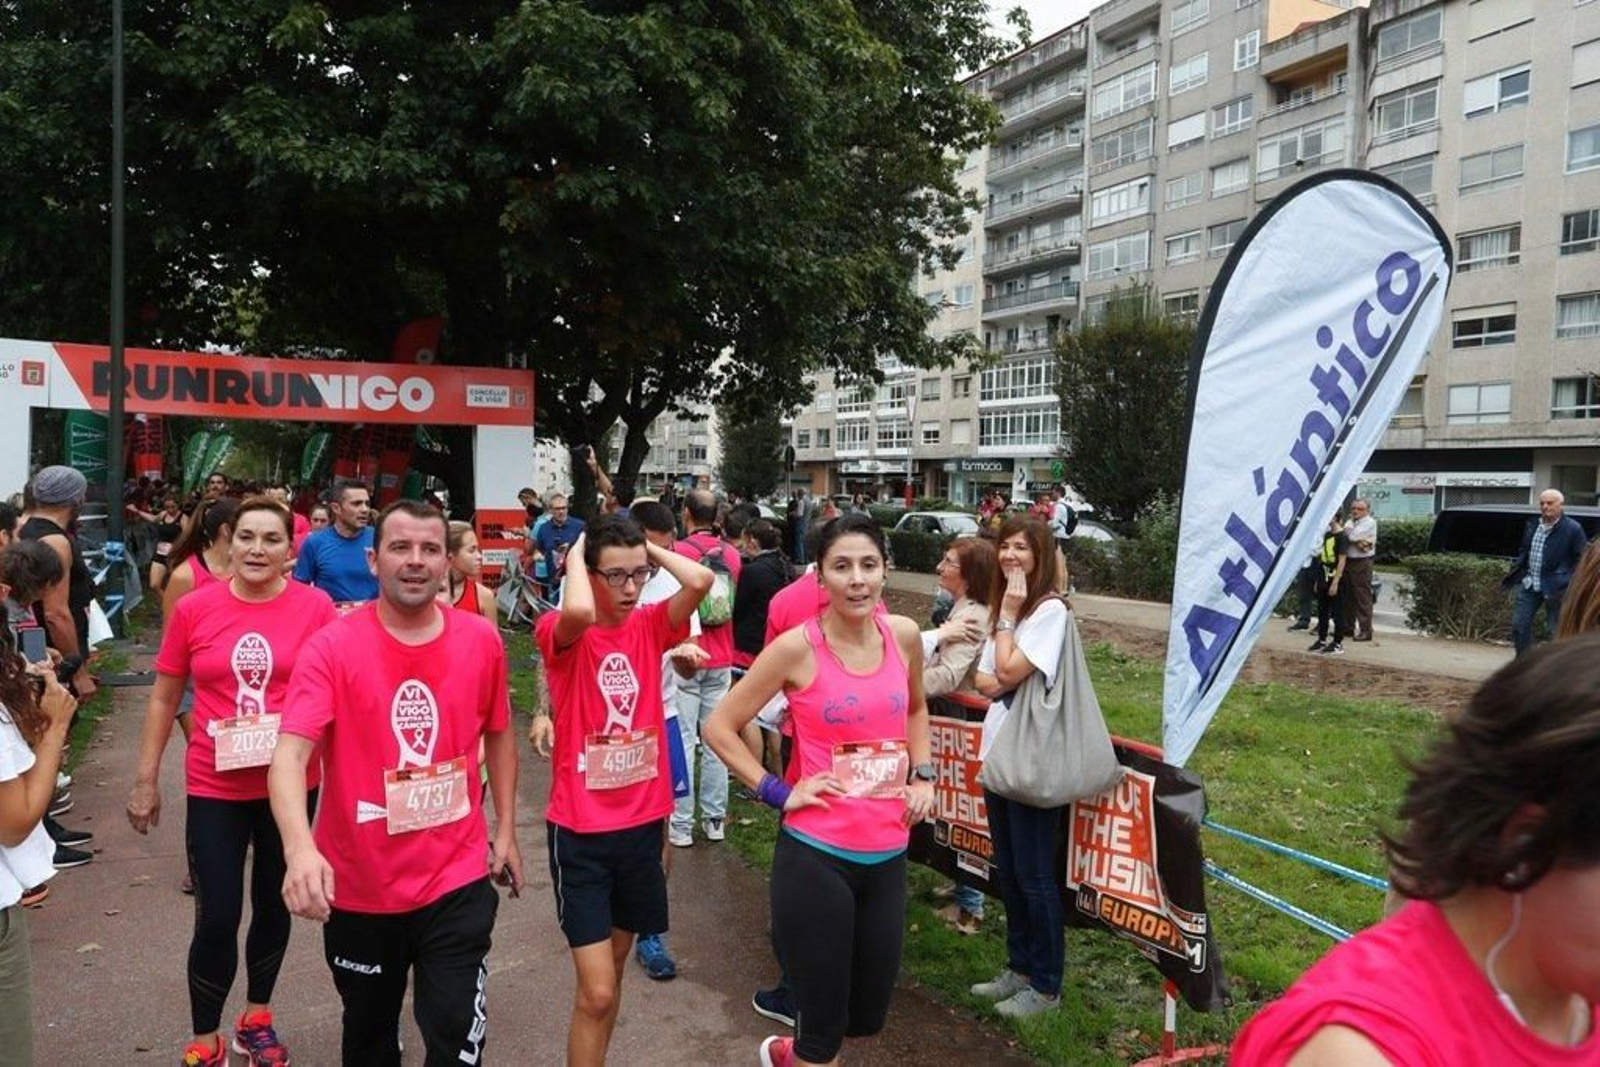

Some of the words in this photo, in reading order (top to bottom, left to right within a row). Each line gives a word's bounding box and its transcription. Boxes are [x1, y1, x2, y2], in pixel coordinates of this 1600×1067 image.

[962, 461, 1002, 471] farmacia
[1182, 250, 1420, 687] Atlántico
[239, 652, 266, 660] VIGO
[611, 660, 624, 671] VI
[604, 676, 630, 686] VIGO
[405, 688, 420, 699] VI
[400, 705, 430, 716] VIGO
[233, 730, 277, 752] 2023
[603, 746, 645, 773] 4902
[407, 779, 454, 812] 4737
[1079, 808, 1133, 853] THE
[1074, 844, 1157, 900] MUSIC
[333, 956, 382, 975] LEGEA
